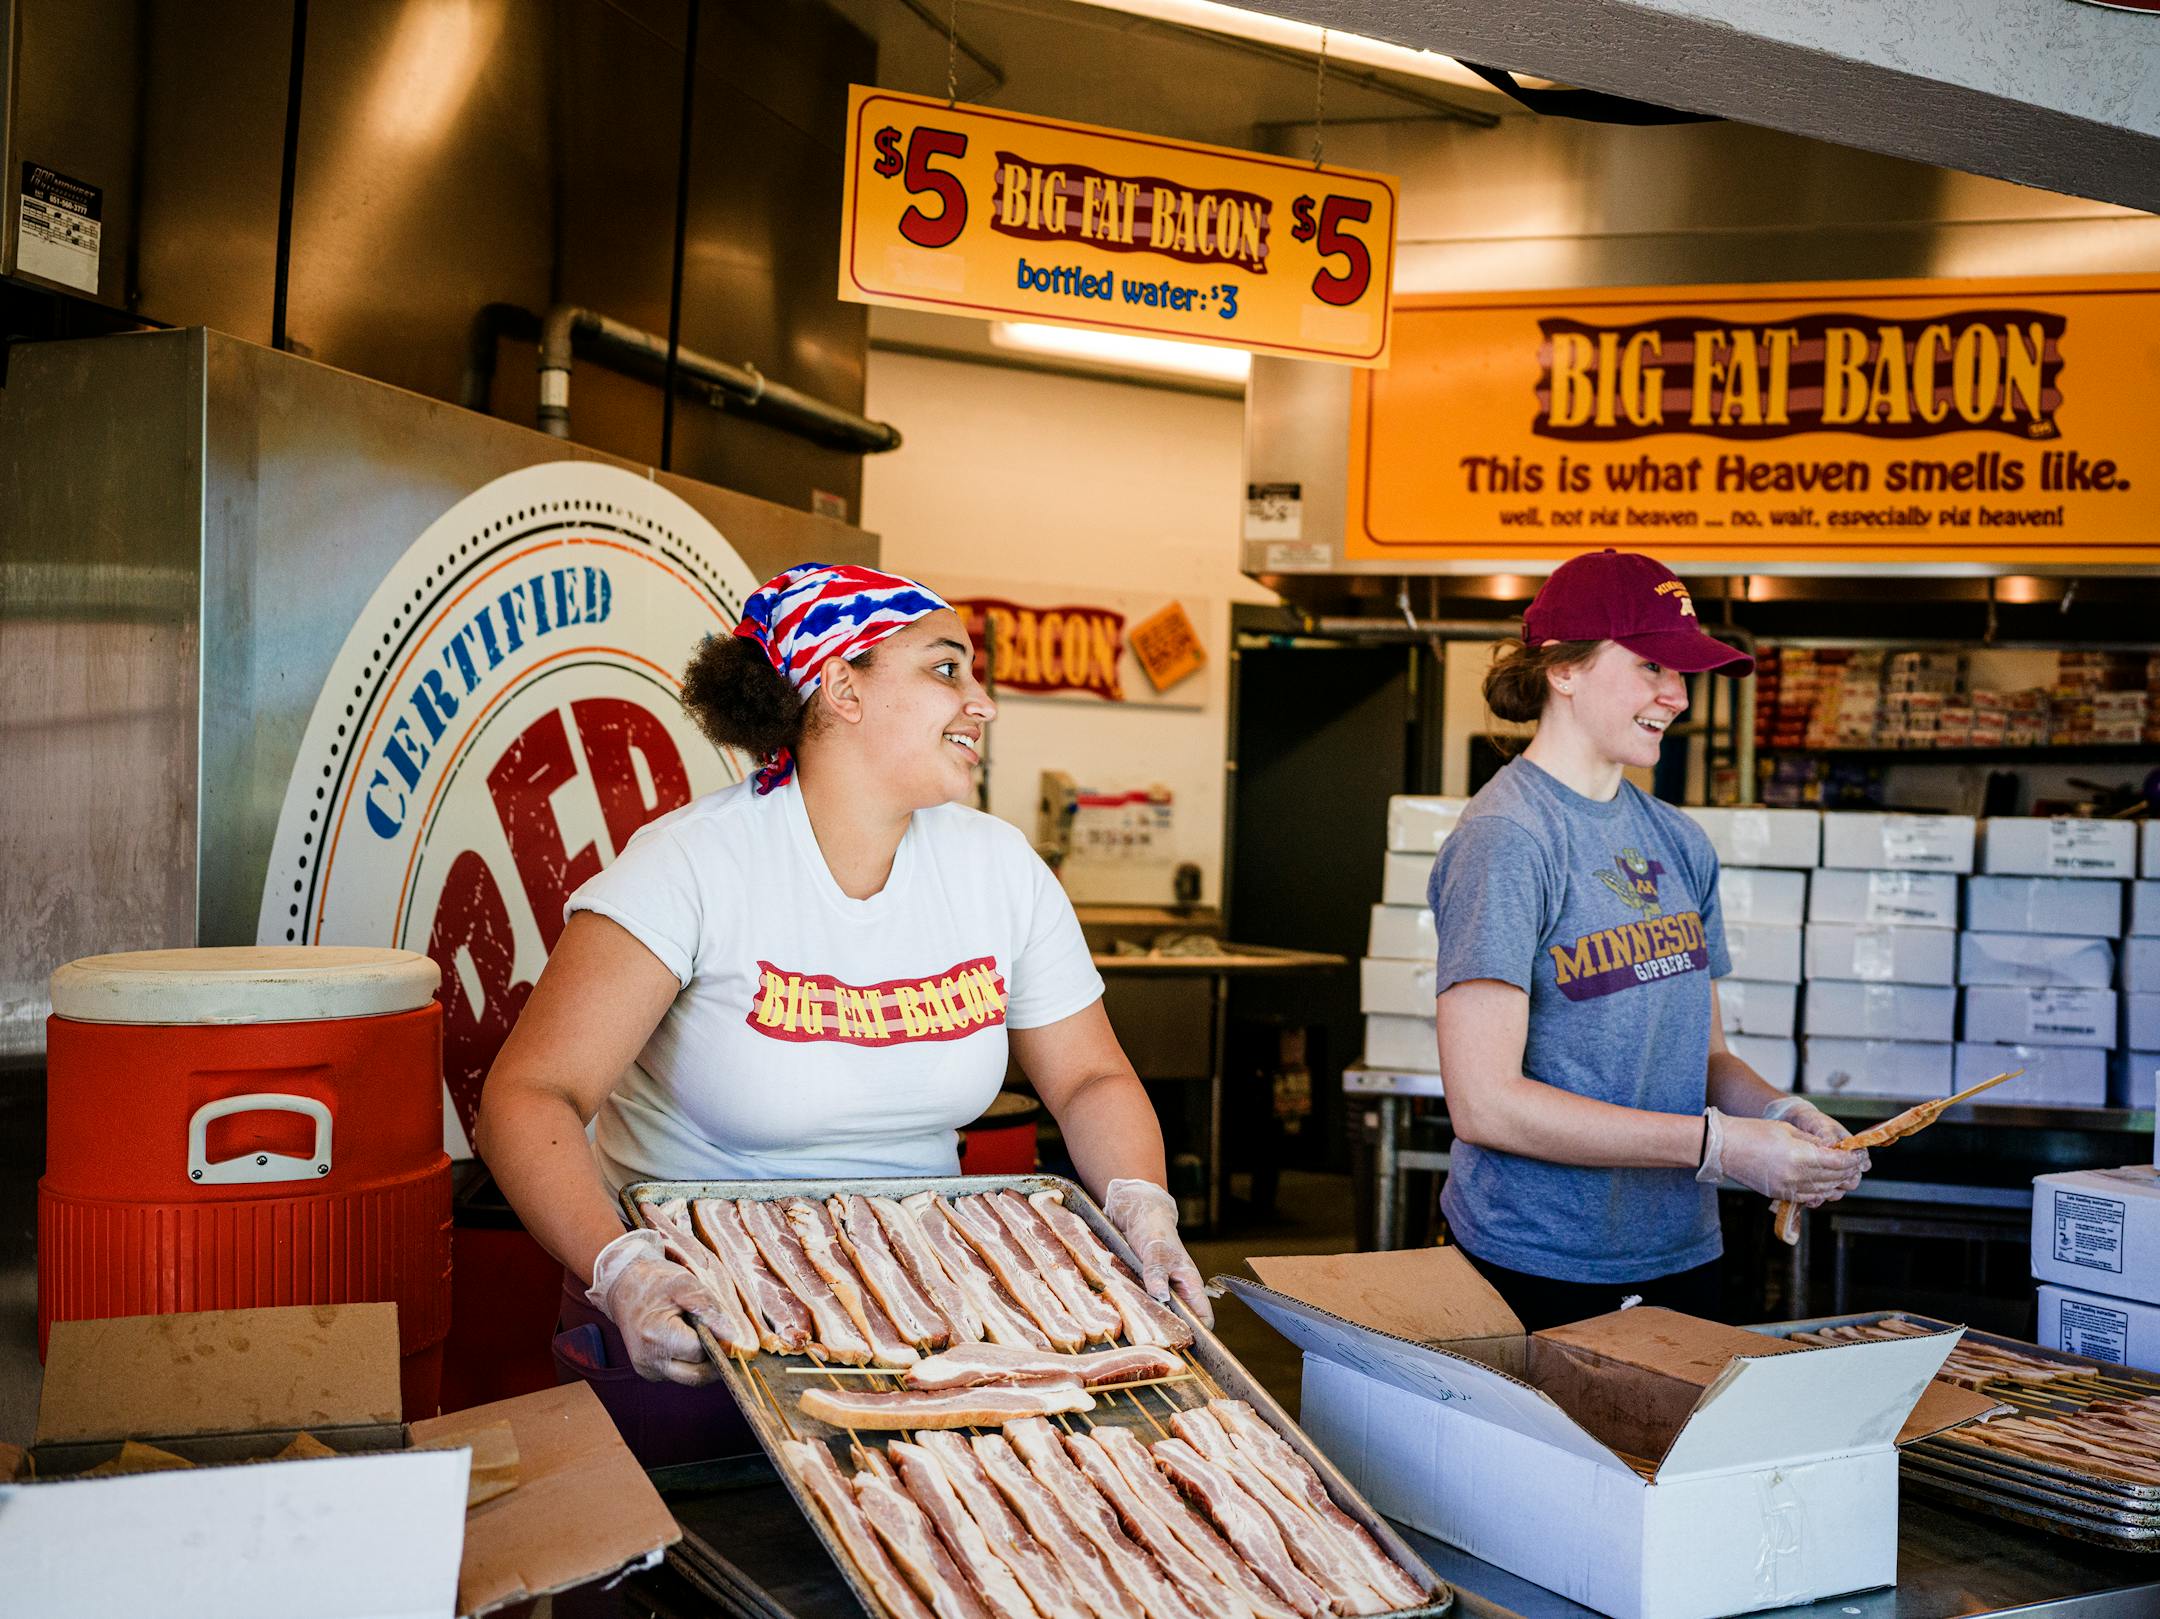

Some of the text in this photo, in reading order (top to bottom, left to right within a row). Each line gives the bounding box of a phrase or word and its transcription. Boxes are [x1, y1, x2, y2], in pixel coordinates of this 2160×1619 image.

[873, 125, 969, 249] $5
[1000, 163, 1262, 263] BIG FAT BACON
[1017, 257, 1114, 301] bottled
[1290, 193, 1373, 307] $5
[1548, 322, 2047, 428] BIG FAT BACON
[1459, 450, 2131, 493] This is what Heaven smells like.
[1551, 509, 1584, 527] not
[1626, 506, 1698, 527] heaven
[1827, 505, 1932, 528] especially
[1978, 505, 2064, 528] heaven!
[987, 606, 1118, 688] BACON
[366, 566, 611, 840] CERTIFIED
[756, 964, 1006, 1039] BIG FAT BACON
